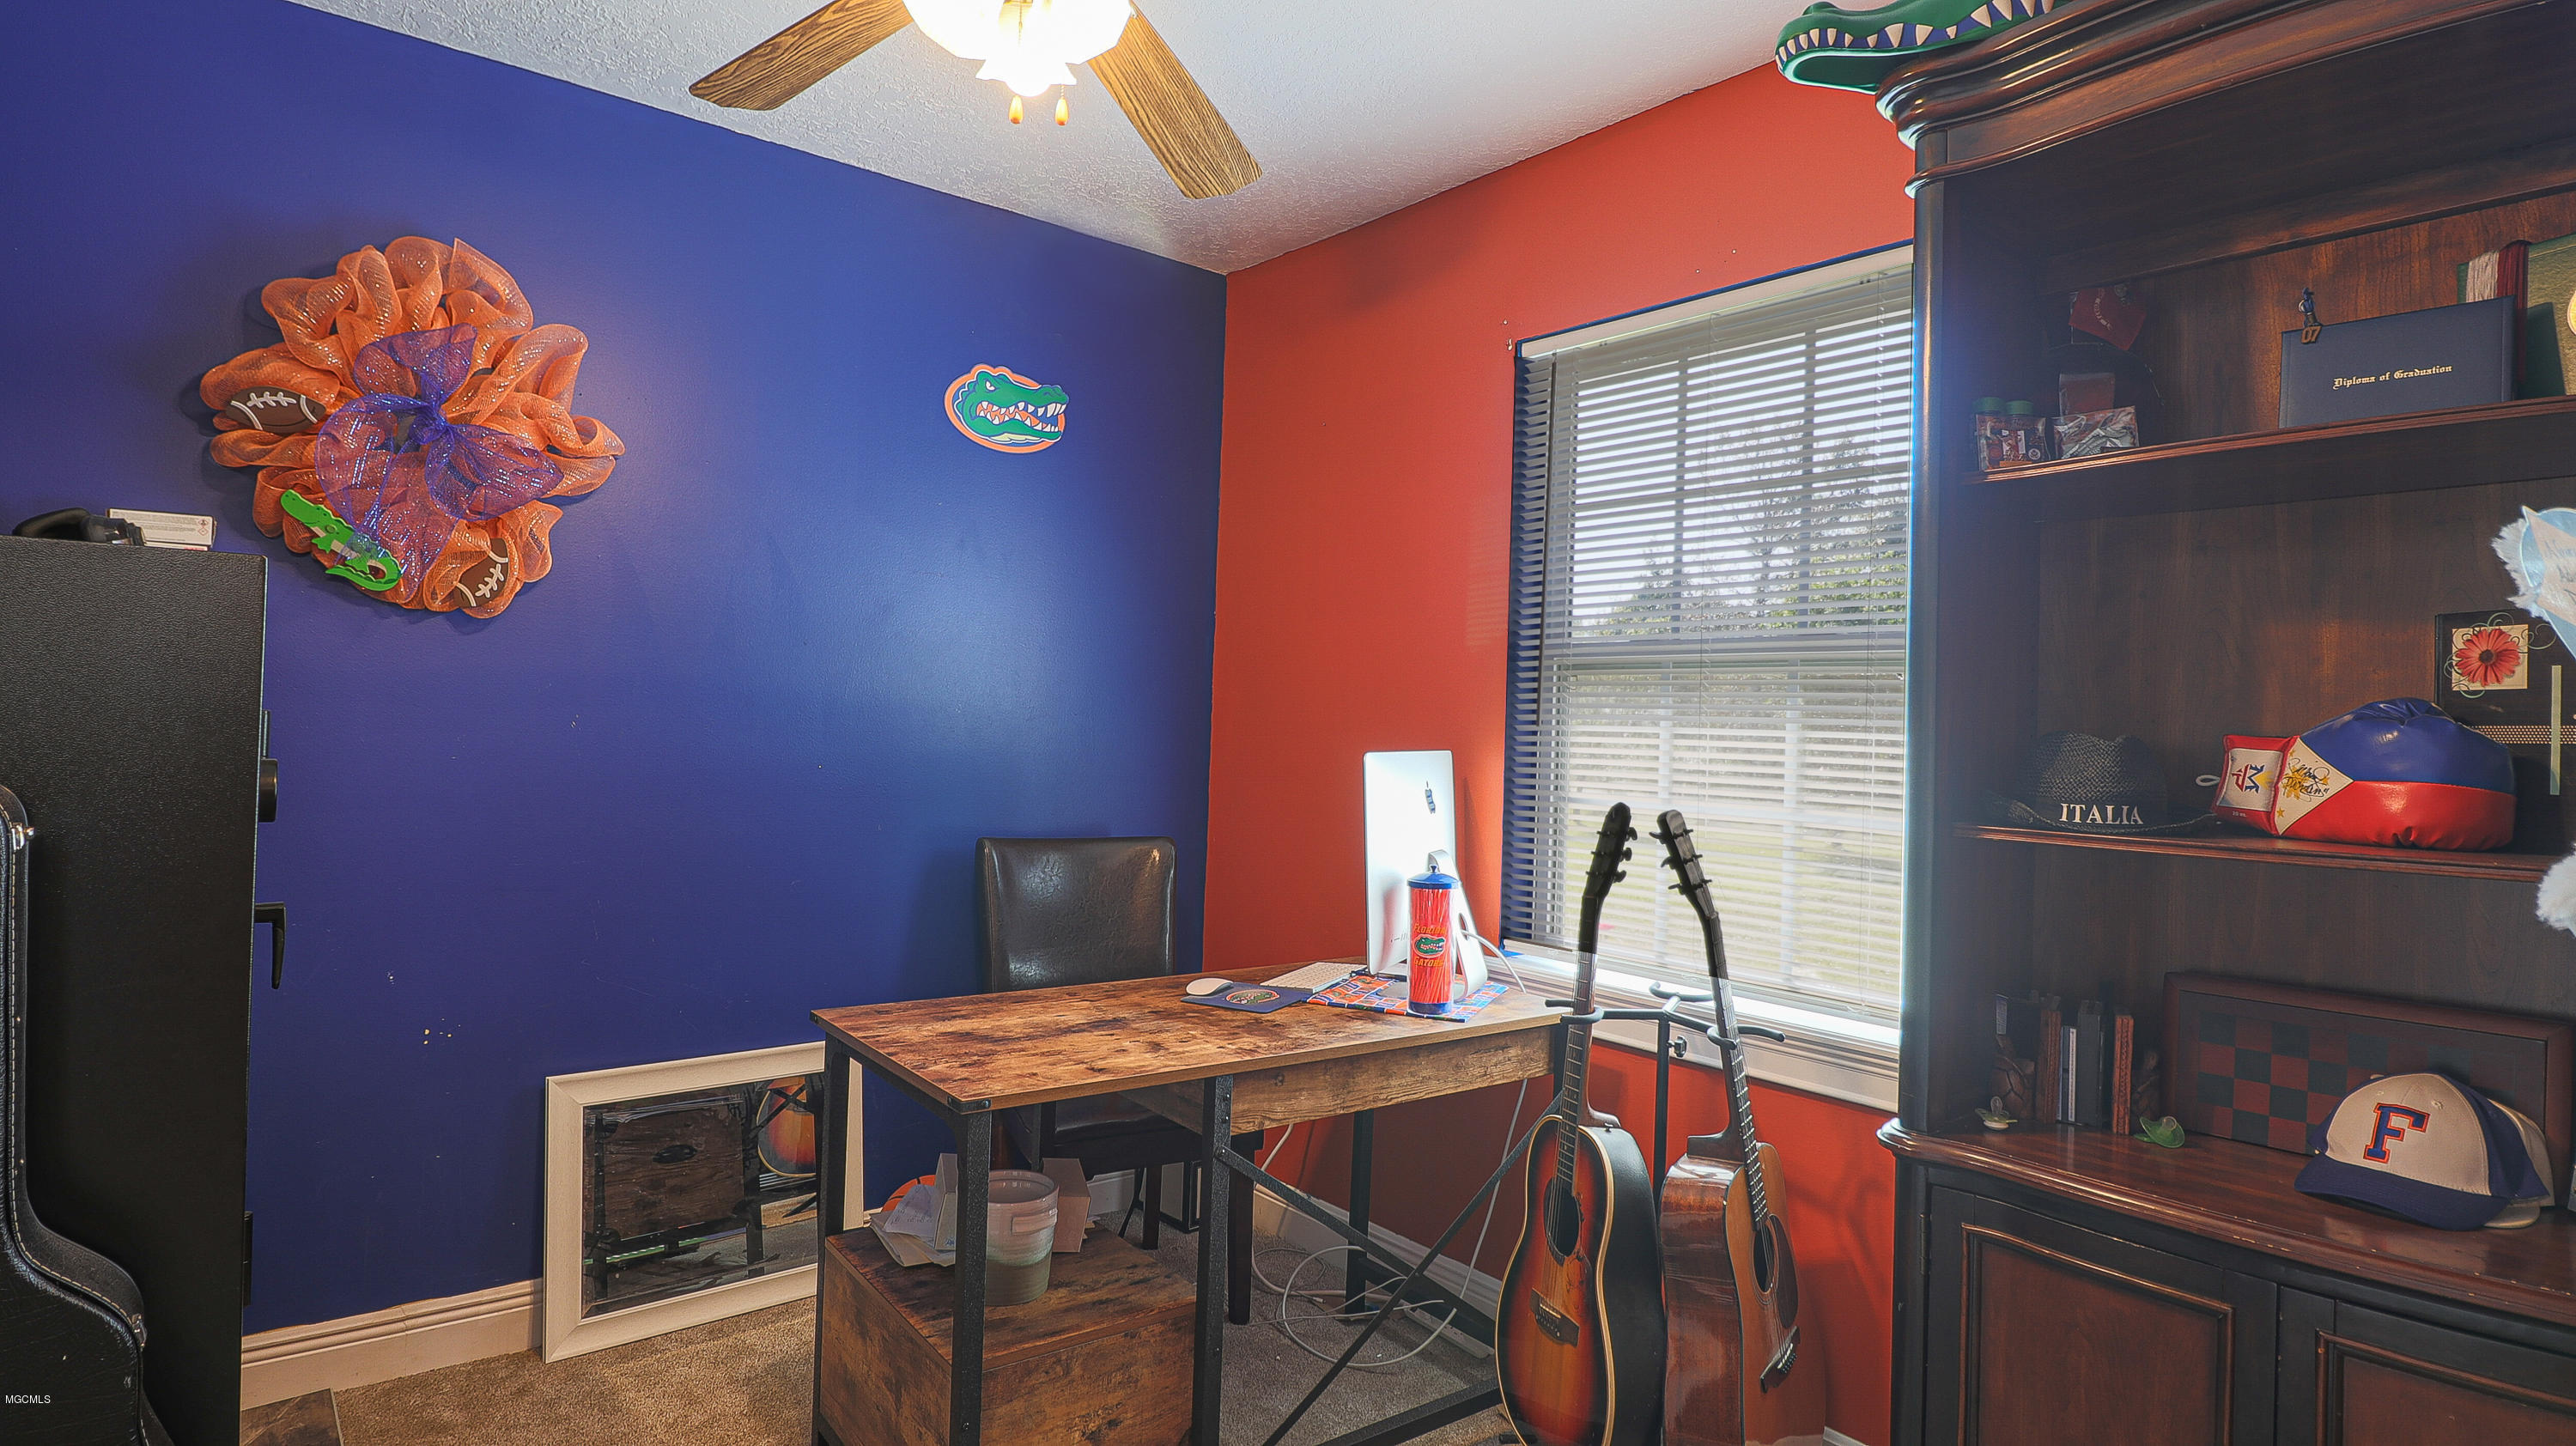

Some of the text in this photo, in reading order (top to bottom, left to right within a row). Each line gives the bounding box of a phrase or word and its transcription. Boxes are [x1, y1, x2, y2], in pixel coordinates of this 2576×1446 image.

[2301, 325, 2322, 343] 07
[2333, 364, 2452, 390] Diploma of Graduation
[2059, 803, 2143, 824] ITALIA
[1413, 922, 1447, 935] FLORIDA
[2363, 1103, 2430, 1164] F
